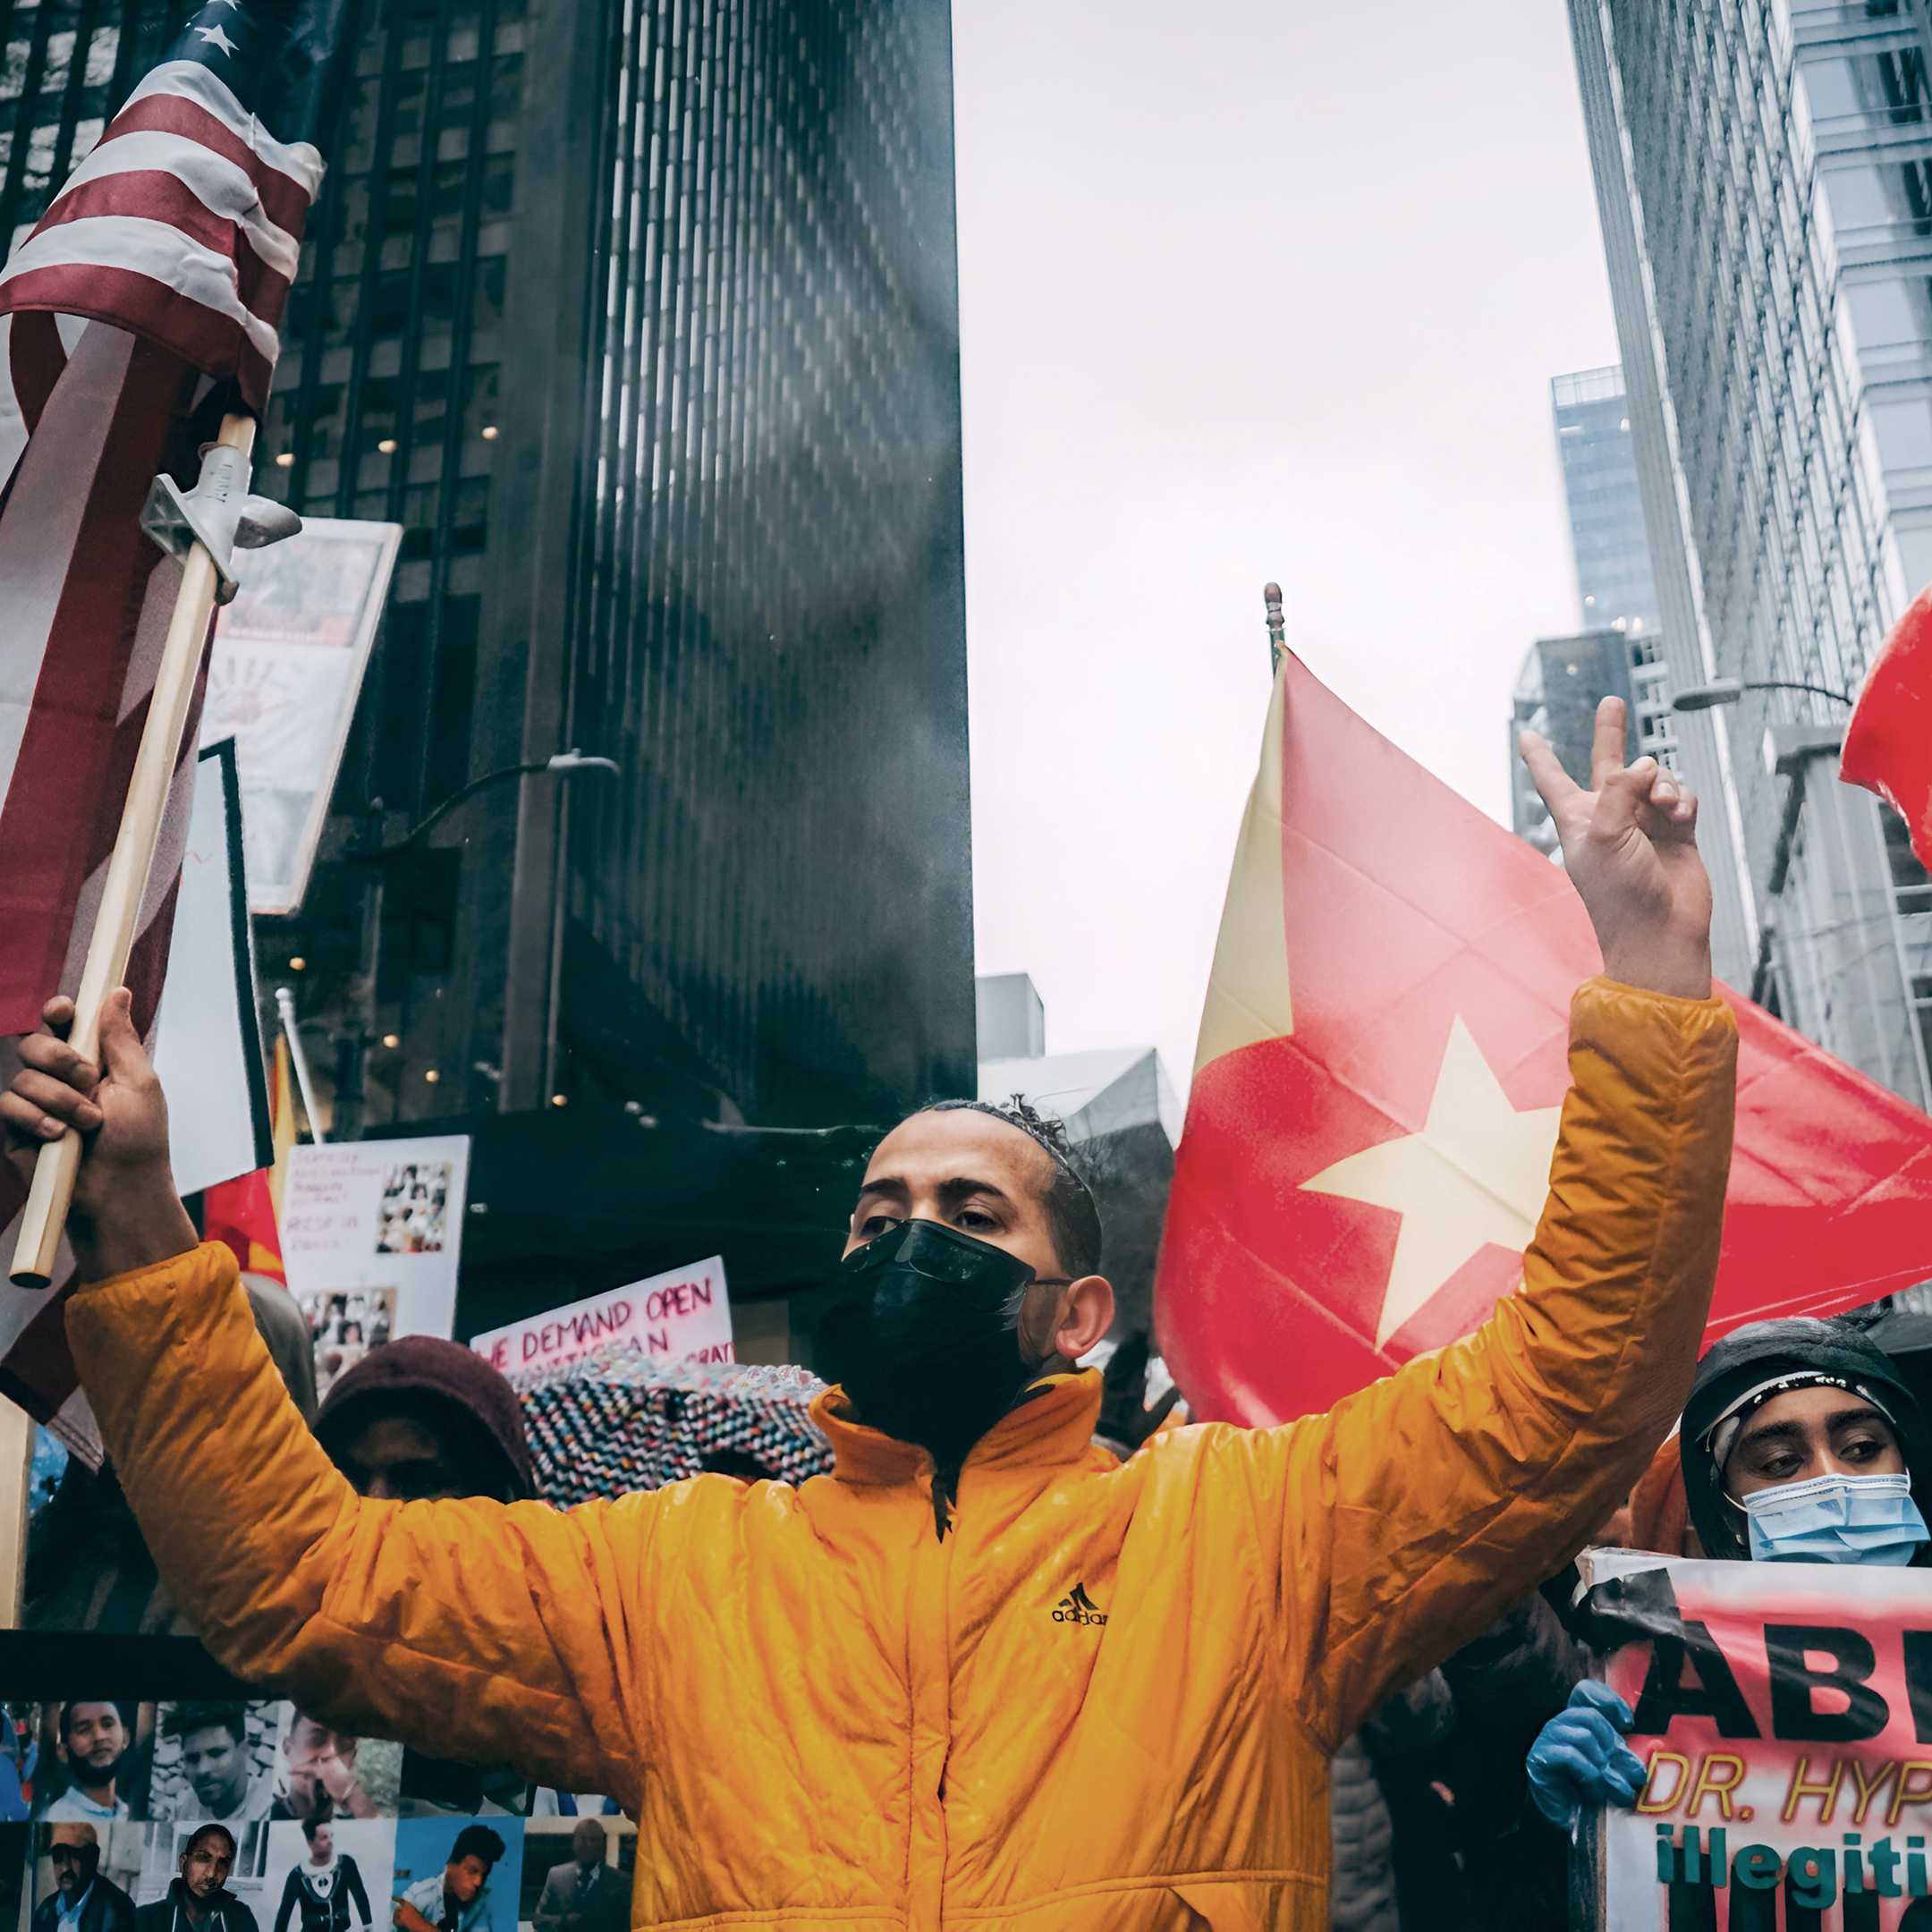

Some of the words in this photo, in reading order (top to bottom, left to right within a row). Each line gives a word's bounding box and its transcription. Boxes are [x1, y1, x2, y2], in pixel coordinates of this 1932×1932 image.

[522, 1300, 631, 1363] DEMAND
[646, 1277, 712, 1321] OPEN
[1635, 1750, 1751, 1819] DR.
[1783, 1758, 1932, 1826] HYP
[1656, 1822, 1928, 1910] illegiti
